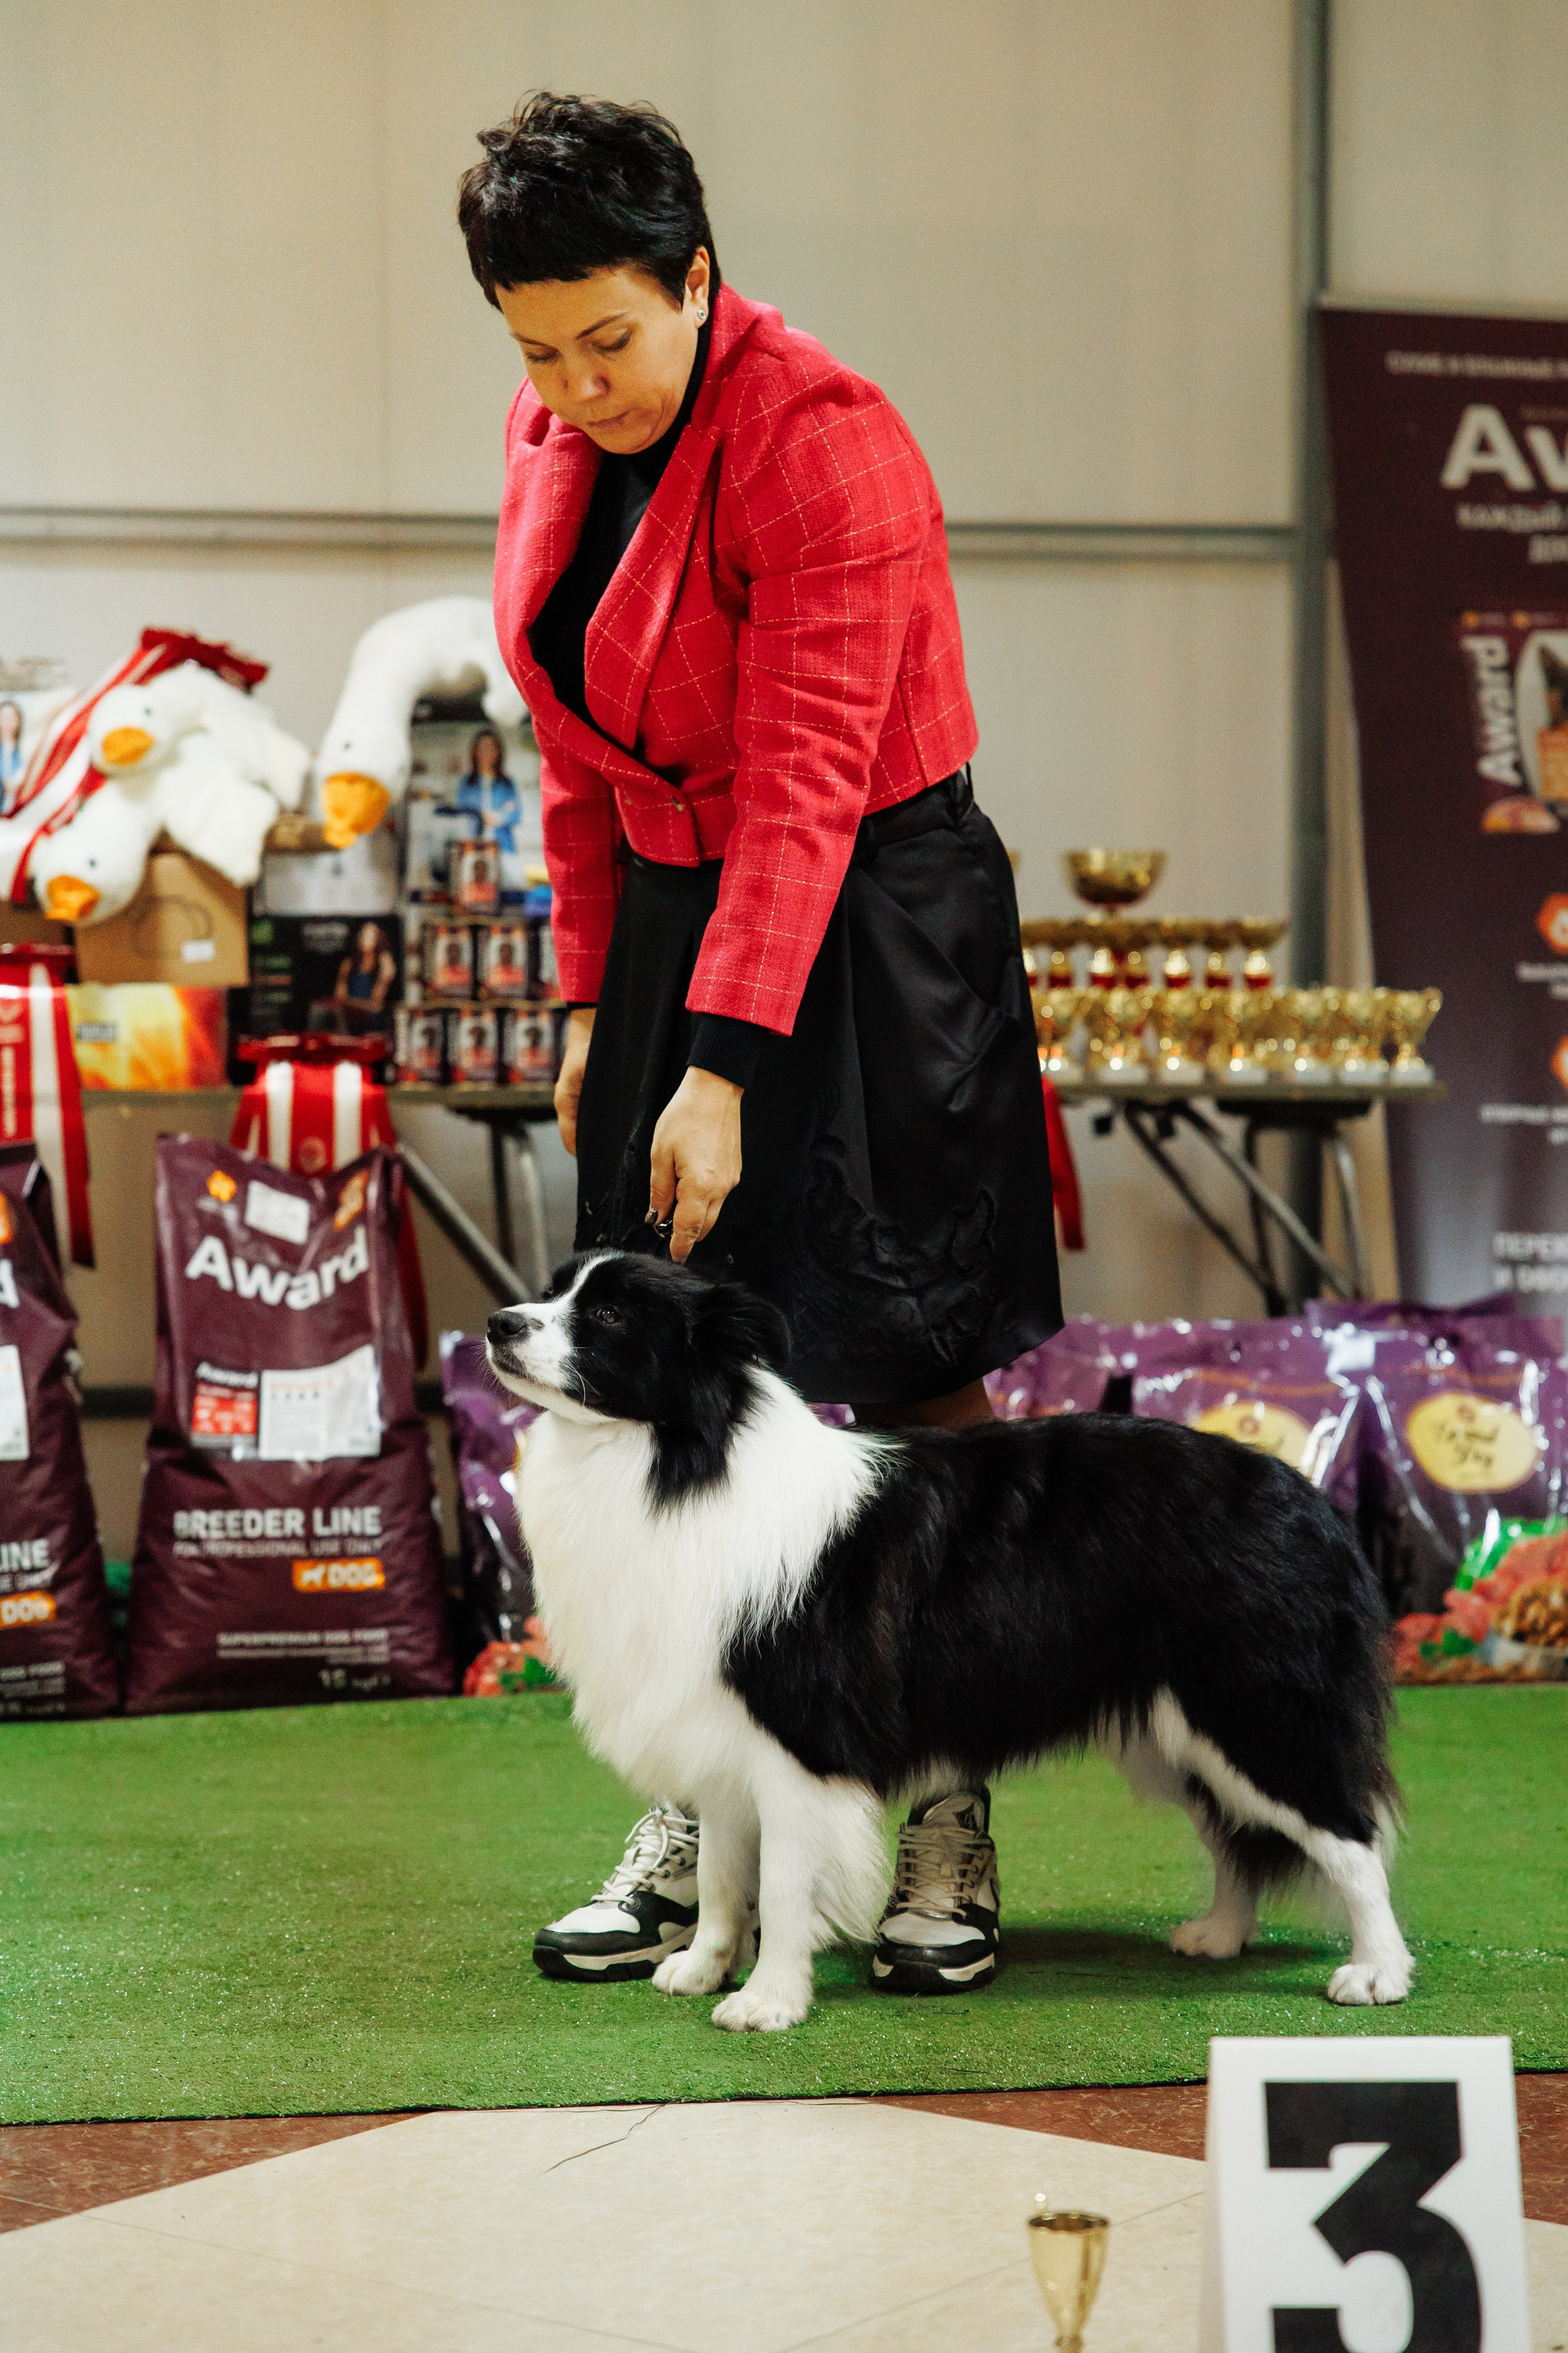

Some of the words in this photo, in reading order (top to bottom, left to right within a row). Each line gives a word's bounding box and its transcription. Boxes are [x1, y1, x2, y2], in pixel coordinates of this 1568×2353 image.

[1460, 635, 1523, 787] Award
[184, 1226, 369, 1310] Award
[173, 1507, 306, 1539] BREEDER
[312, 1505, 382, 1536] LINE
[0, 1539, 49, 1571] INE
[327, 1563, 376, 1586] DOG
[1263, 2079, 1483, 2353] 3
